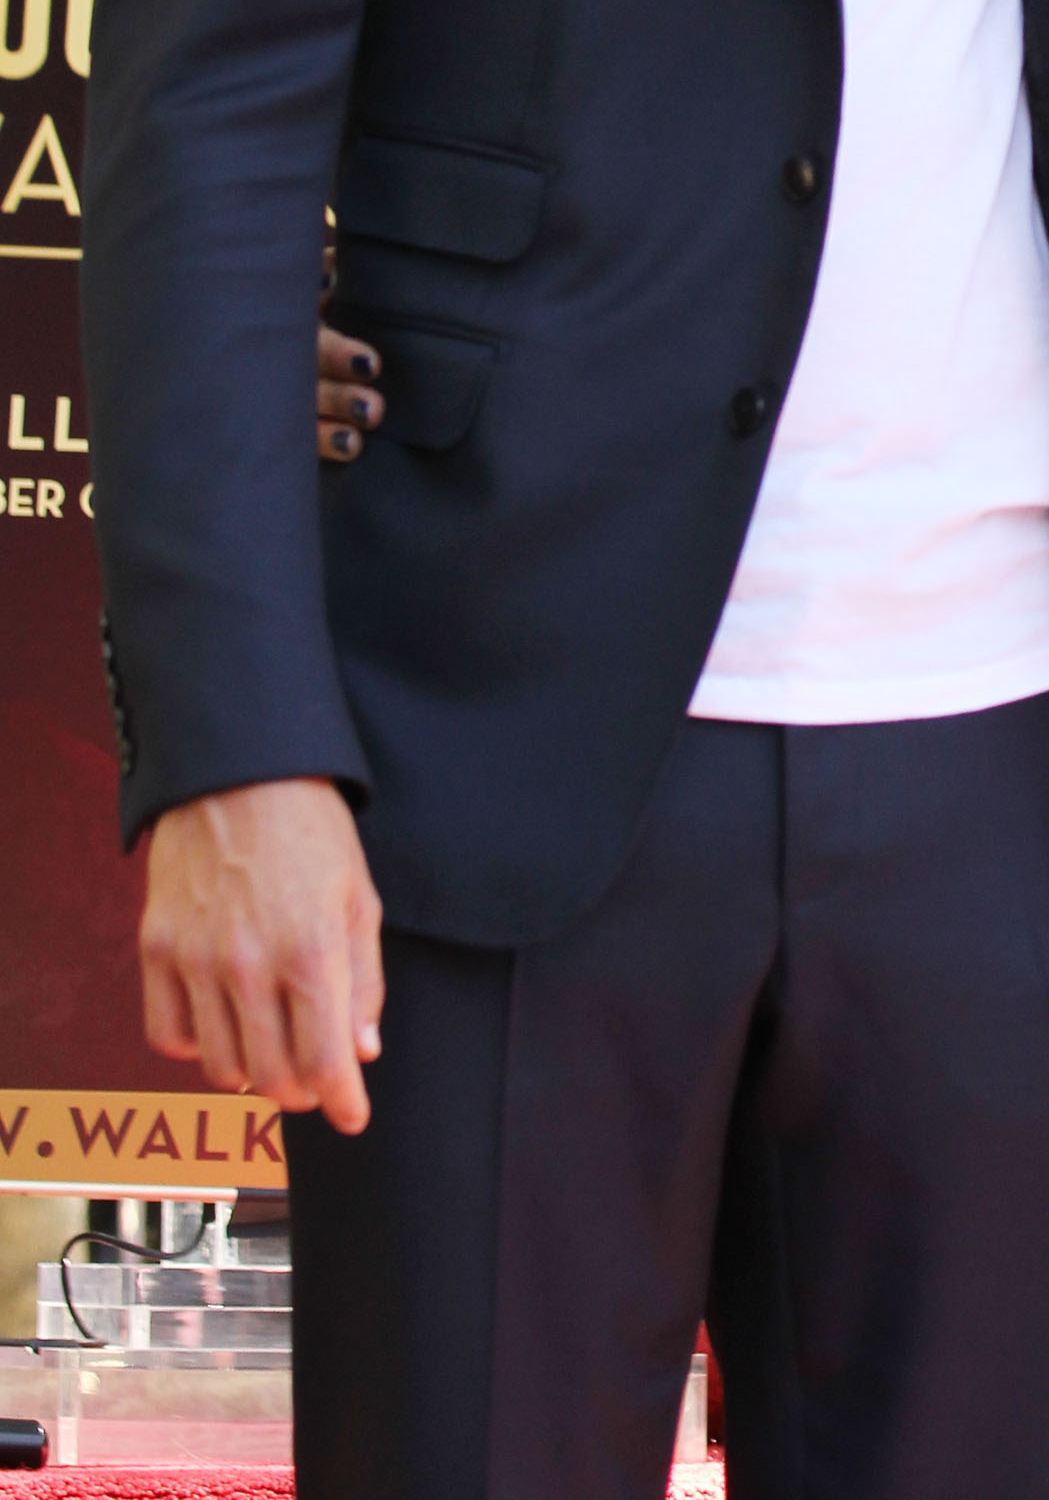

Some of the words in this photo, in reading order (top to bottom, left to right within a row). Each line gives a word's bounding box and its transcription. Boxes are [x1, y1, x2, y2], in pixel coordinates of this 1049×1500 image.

[0, 111, 82, 217] A
[8, 393, 89, 453] LL
[0, 477, 66, 518] ER
